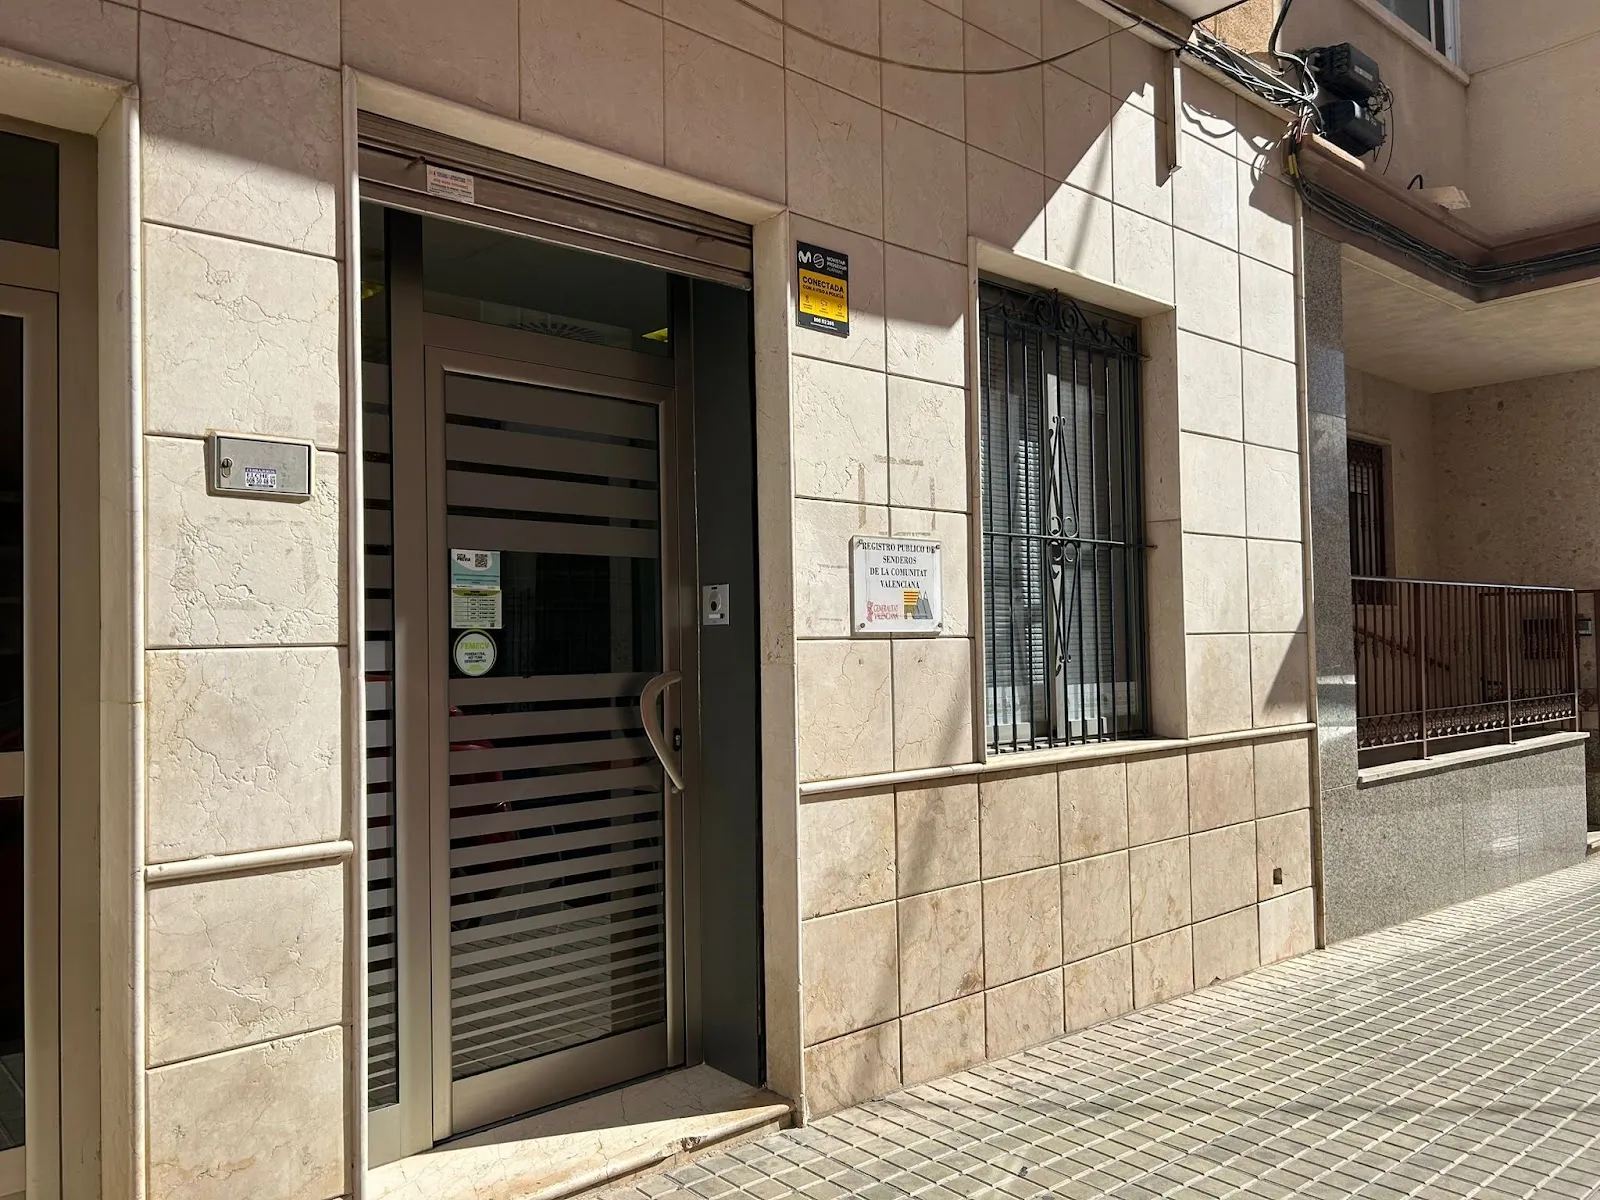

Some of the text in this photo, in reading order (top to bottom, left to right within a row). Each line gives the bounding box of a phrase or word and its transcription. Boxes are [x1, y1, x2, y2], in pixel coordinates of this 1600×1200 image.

[802, 276, 844, 294] CONECTADA
[862, 542, 936, 554] REGISTRO PUBLICO DE
[882, 555, 917, 565] SENDEROS
[869, 567, 928, 577] DE LA COMUNITAT
[880, 580, 920, 589] VALENCIANA
[873, 604, 899, 612] GENERALITAT
[873, 612, 899, 620] VALENCIANA
[461, 642, 489, 650] FEMECV
